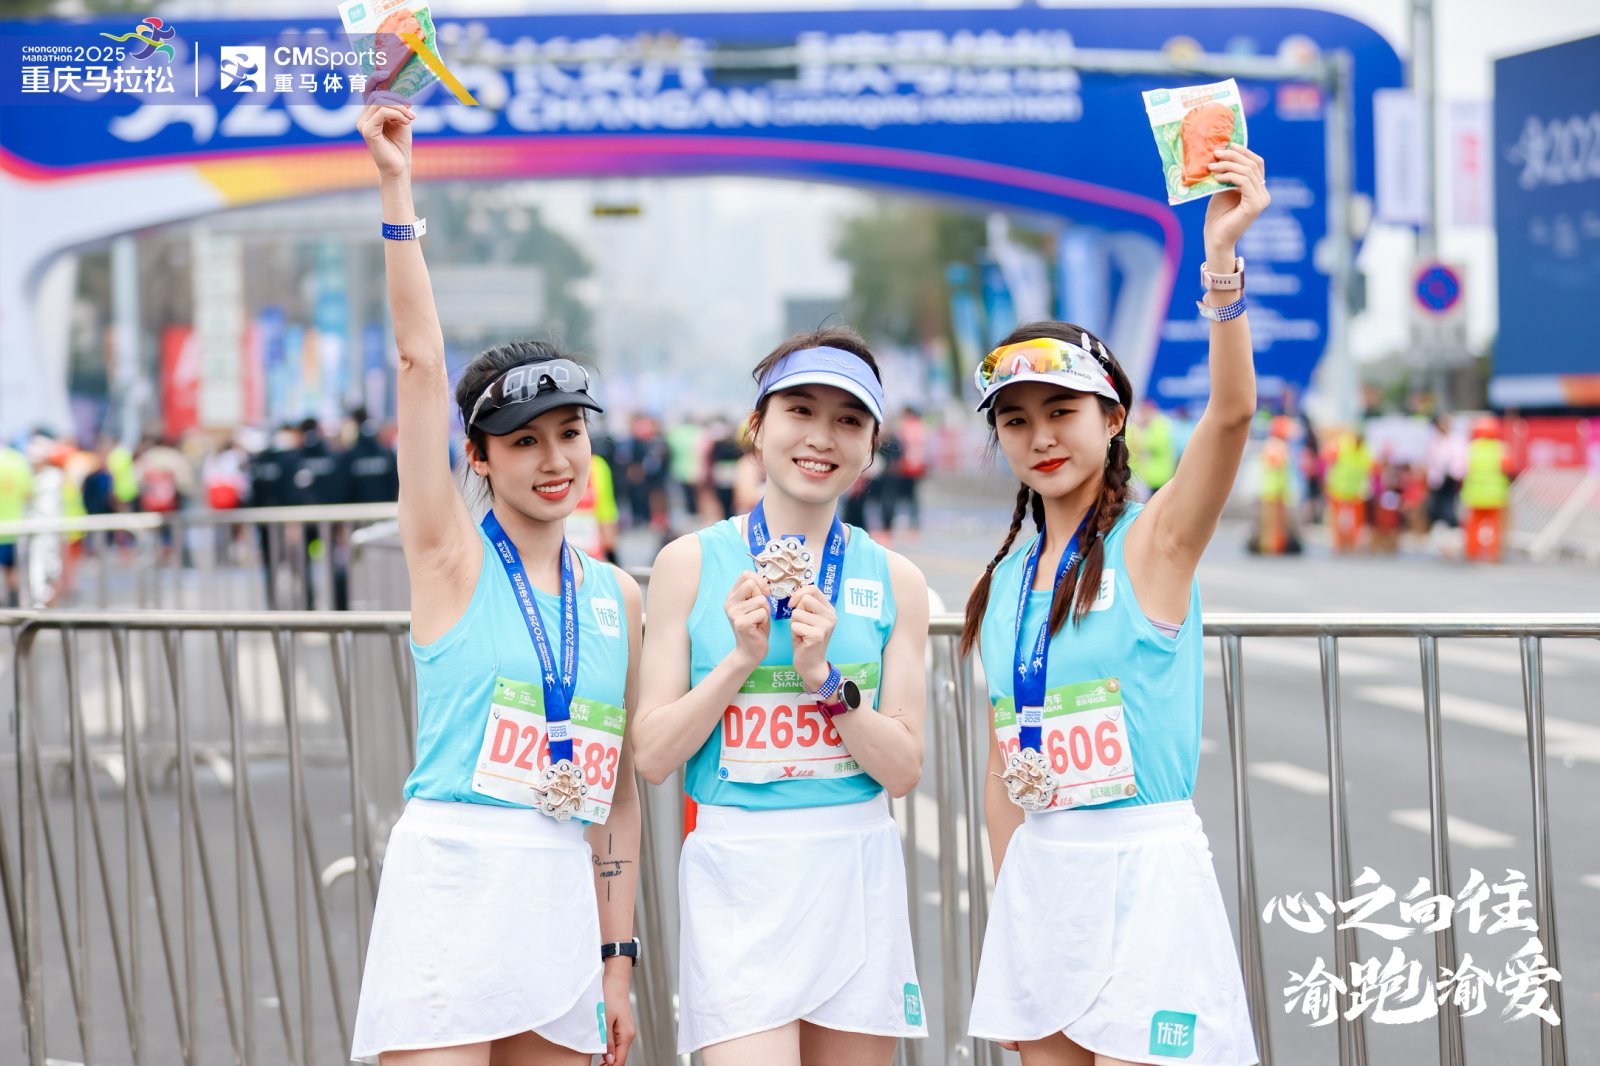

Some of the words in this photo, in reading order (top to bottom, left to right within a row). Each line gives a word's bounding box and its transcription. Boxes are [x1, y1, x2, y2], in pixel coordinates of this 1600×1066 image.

[849, 587, 879, 609] 优形
[724, 704, 843, 749] D2658
[1157, 1022, 1190, 1047] 优形
